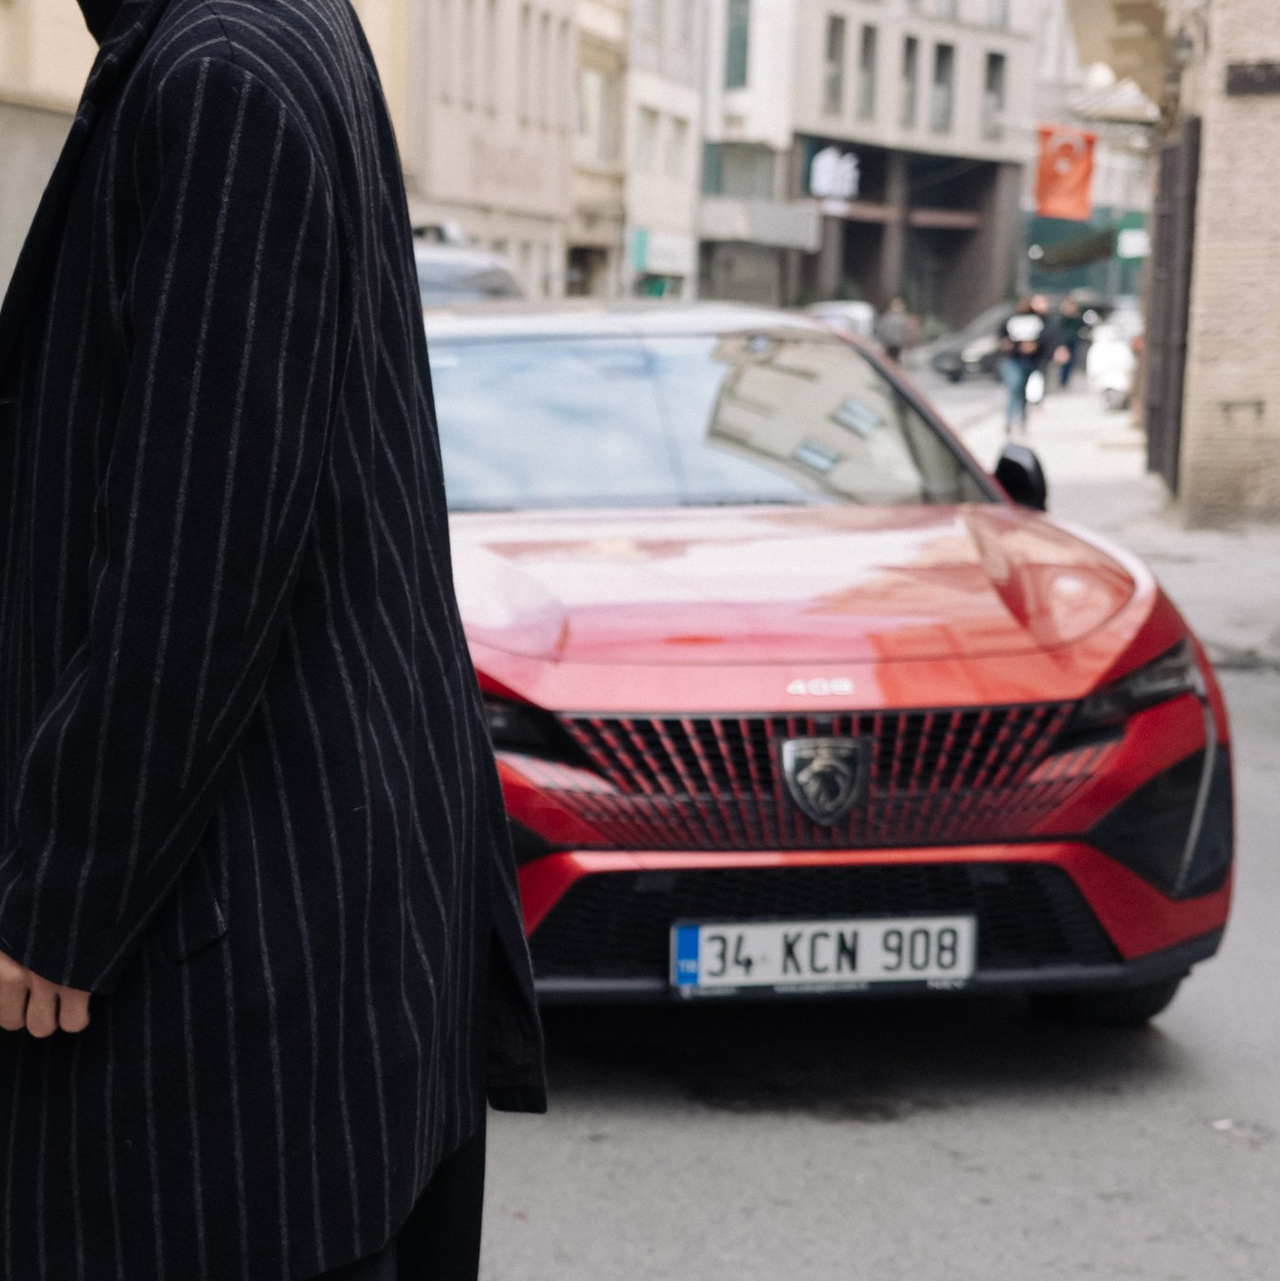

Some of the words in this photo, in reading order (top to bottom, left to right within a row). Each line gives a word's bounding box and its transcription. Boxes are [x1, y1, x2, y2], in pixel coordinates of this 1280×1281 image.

[786, 677, 852, 696] 408
[706, 934, 754, 977] 34
[782, 930, 859, 975] KCN
[882, 927, 958, 972] 908
